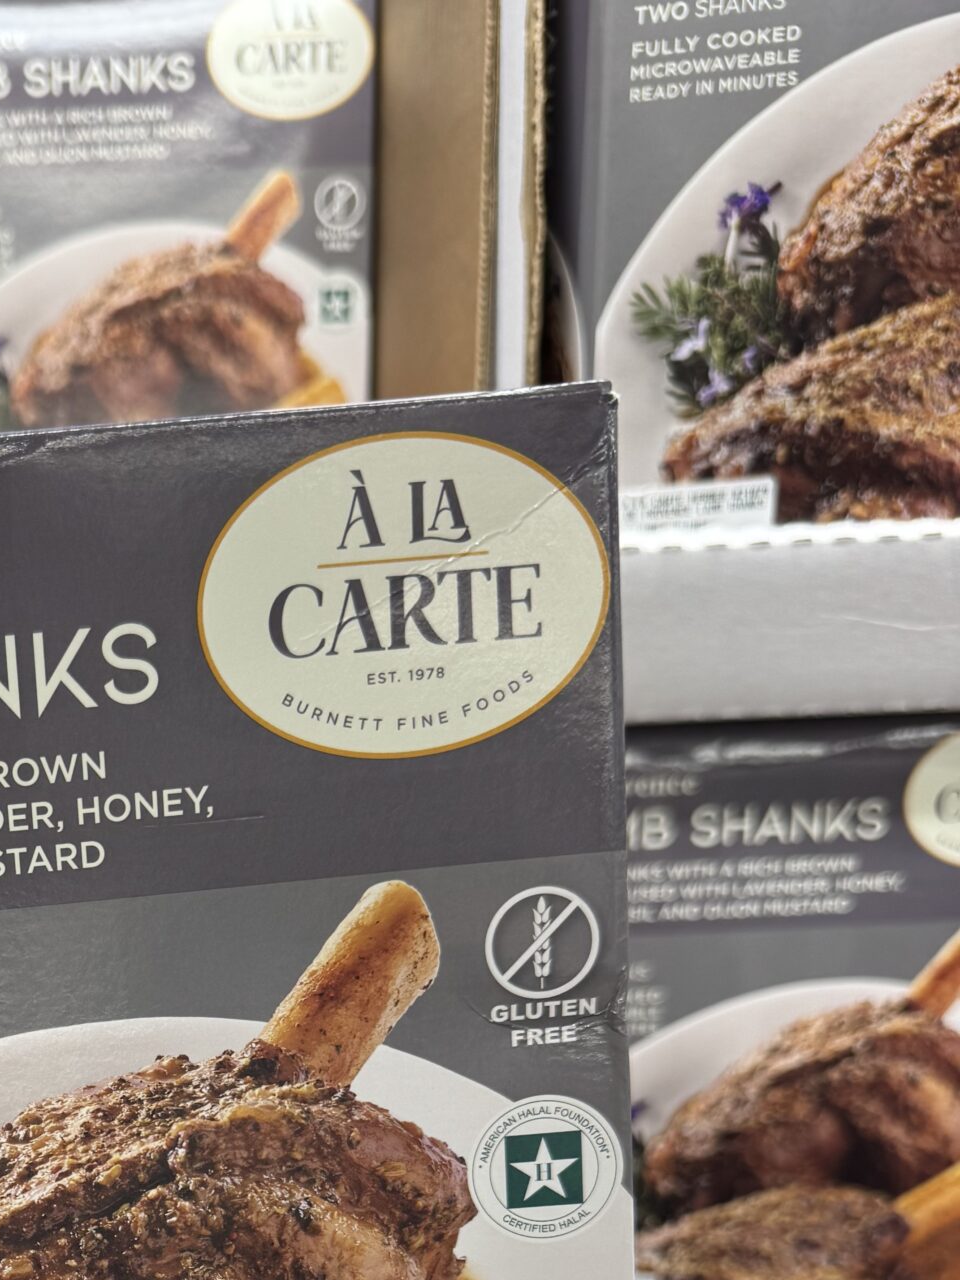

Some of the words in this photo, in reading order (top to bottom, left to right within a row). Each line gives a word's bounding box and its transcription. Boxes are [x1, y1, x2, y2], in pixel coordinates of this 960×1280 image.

[634, 1, 689, 25] TWO
[235, 39, 348, 76] CARTE
[631, 35, 700, 59] FULLY
[706, 25, 802, 49] COOKED
[23, 52, 196, 98] SHANKS
[630, 49, 801, 81] MICROWAVEABLE
[629, 82, 691, 103] READY
[696, 79, 714, 95] IN
[718, 70, 799, 93] MINUTES
[337, 469, 385, 550] À
[409, 478, 472, 543] LA
[268, 563, 543, 659] CARTE
[367, 671, 401, 685] EST.
[409, 667, 445, 682] 1978
[281, 692, 383, 731] BURNETT
[396, 710, 449, 731] FINE
[461, 669, 535, 718] FOODS
[76, 785, 215, 826] HONEY,
[690, 797, 892, 848] SHANKS
[490, 997, 597, 1023] GLUTEN
[511, 1025, 578, 1048] FREE
[481, 1115, 517, 1164] AMERICAN
[518, 1106, 552, 1121] HALAL
[502, 1214, 557, 1233] CERTIFIED
[558, 1209, 592, 1230] HALAL
